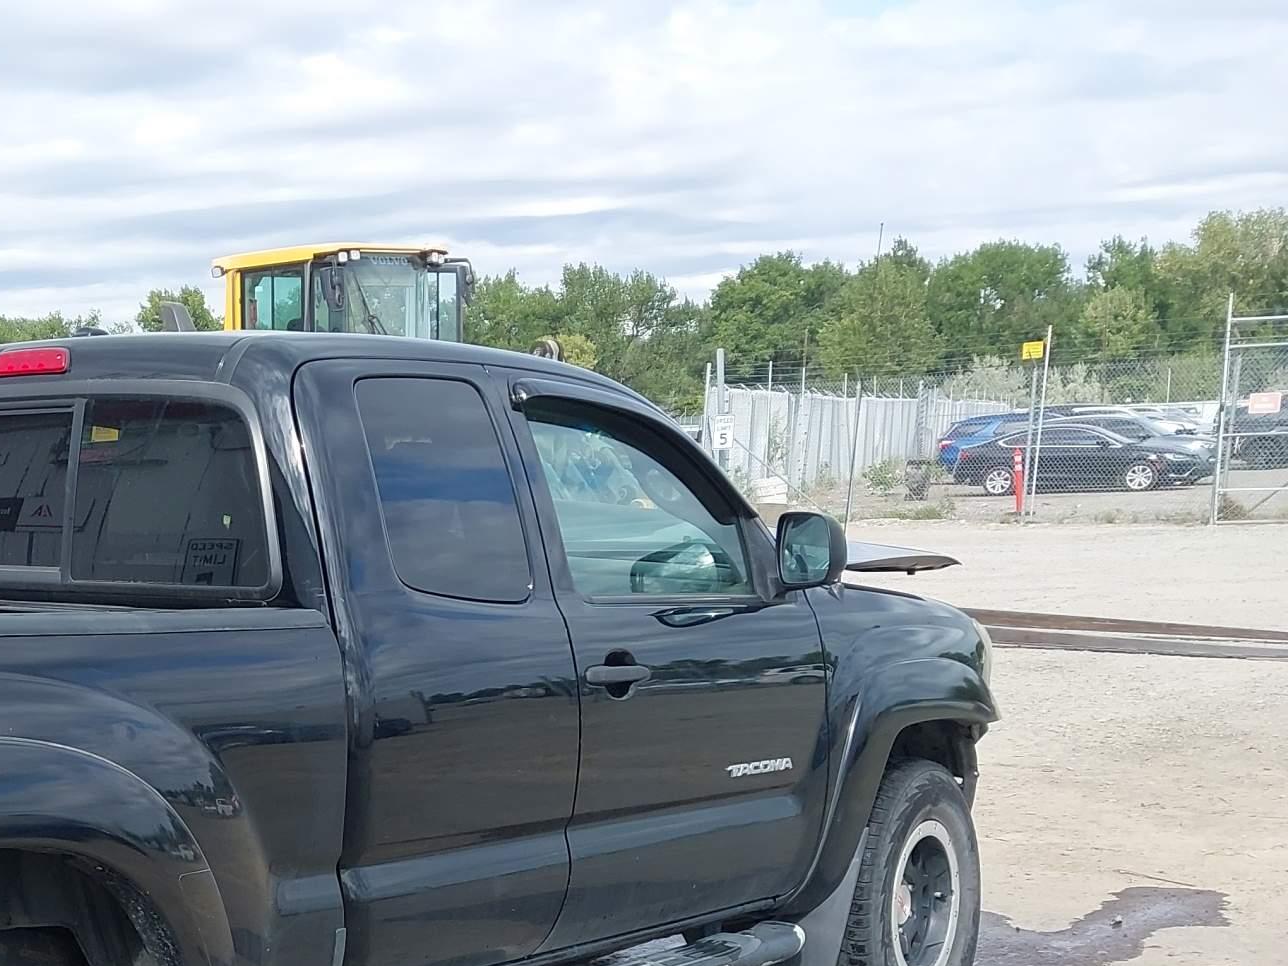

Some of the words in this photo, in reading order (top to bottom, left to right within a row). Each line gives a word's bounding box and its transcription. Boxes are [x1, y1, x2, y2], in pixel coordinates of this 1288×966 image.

[368, 255, 409, 265] VOLVO
[719, 433, 727, 445] 5
[725, 757, 793, 777] TACOMA
